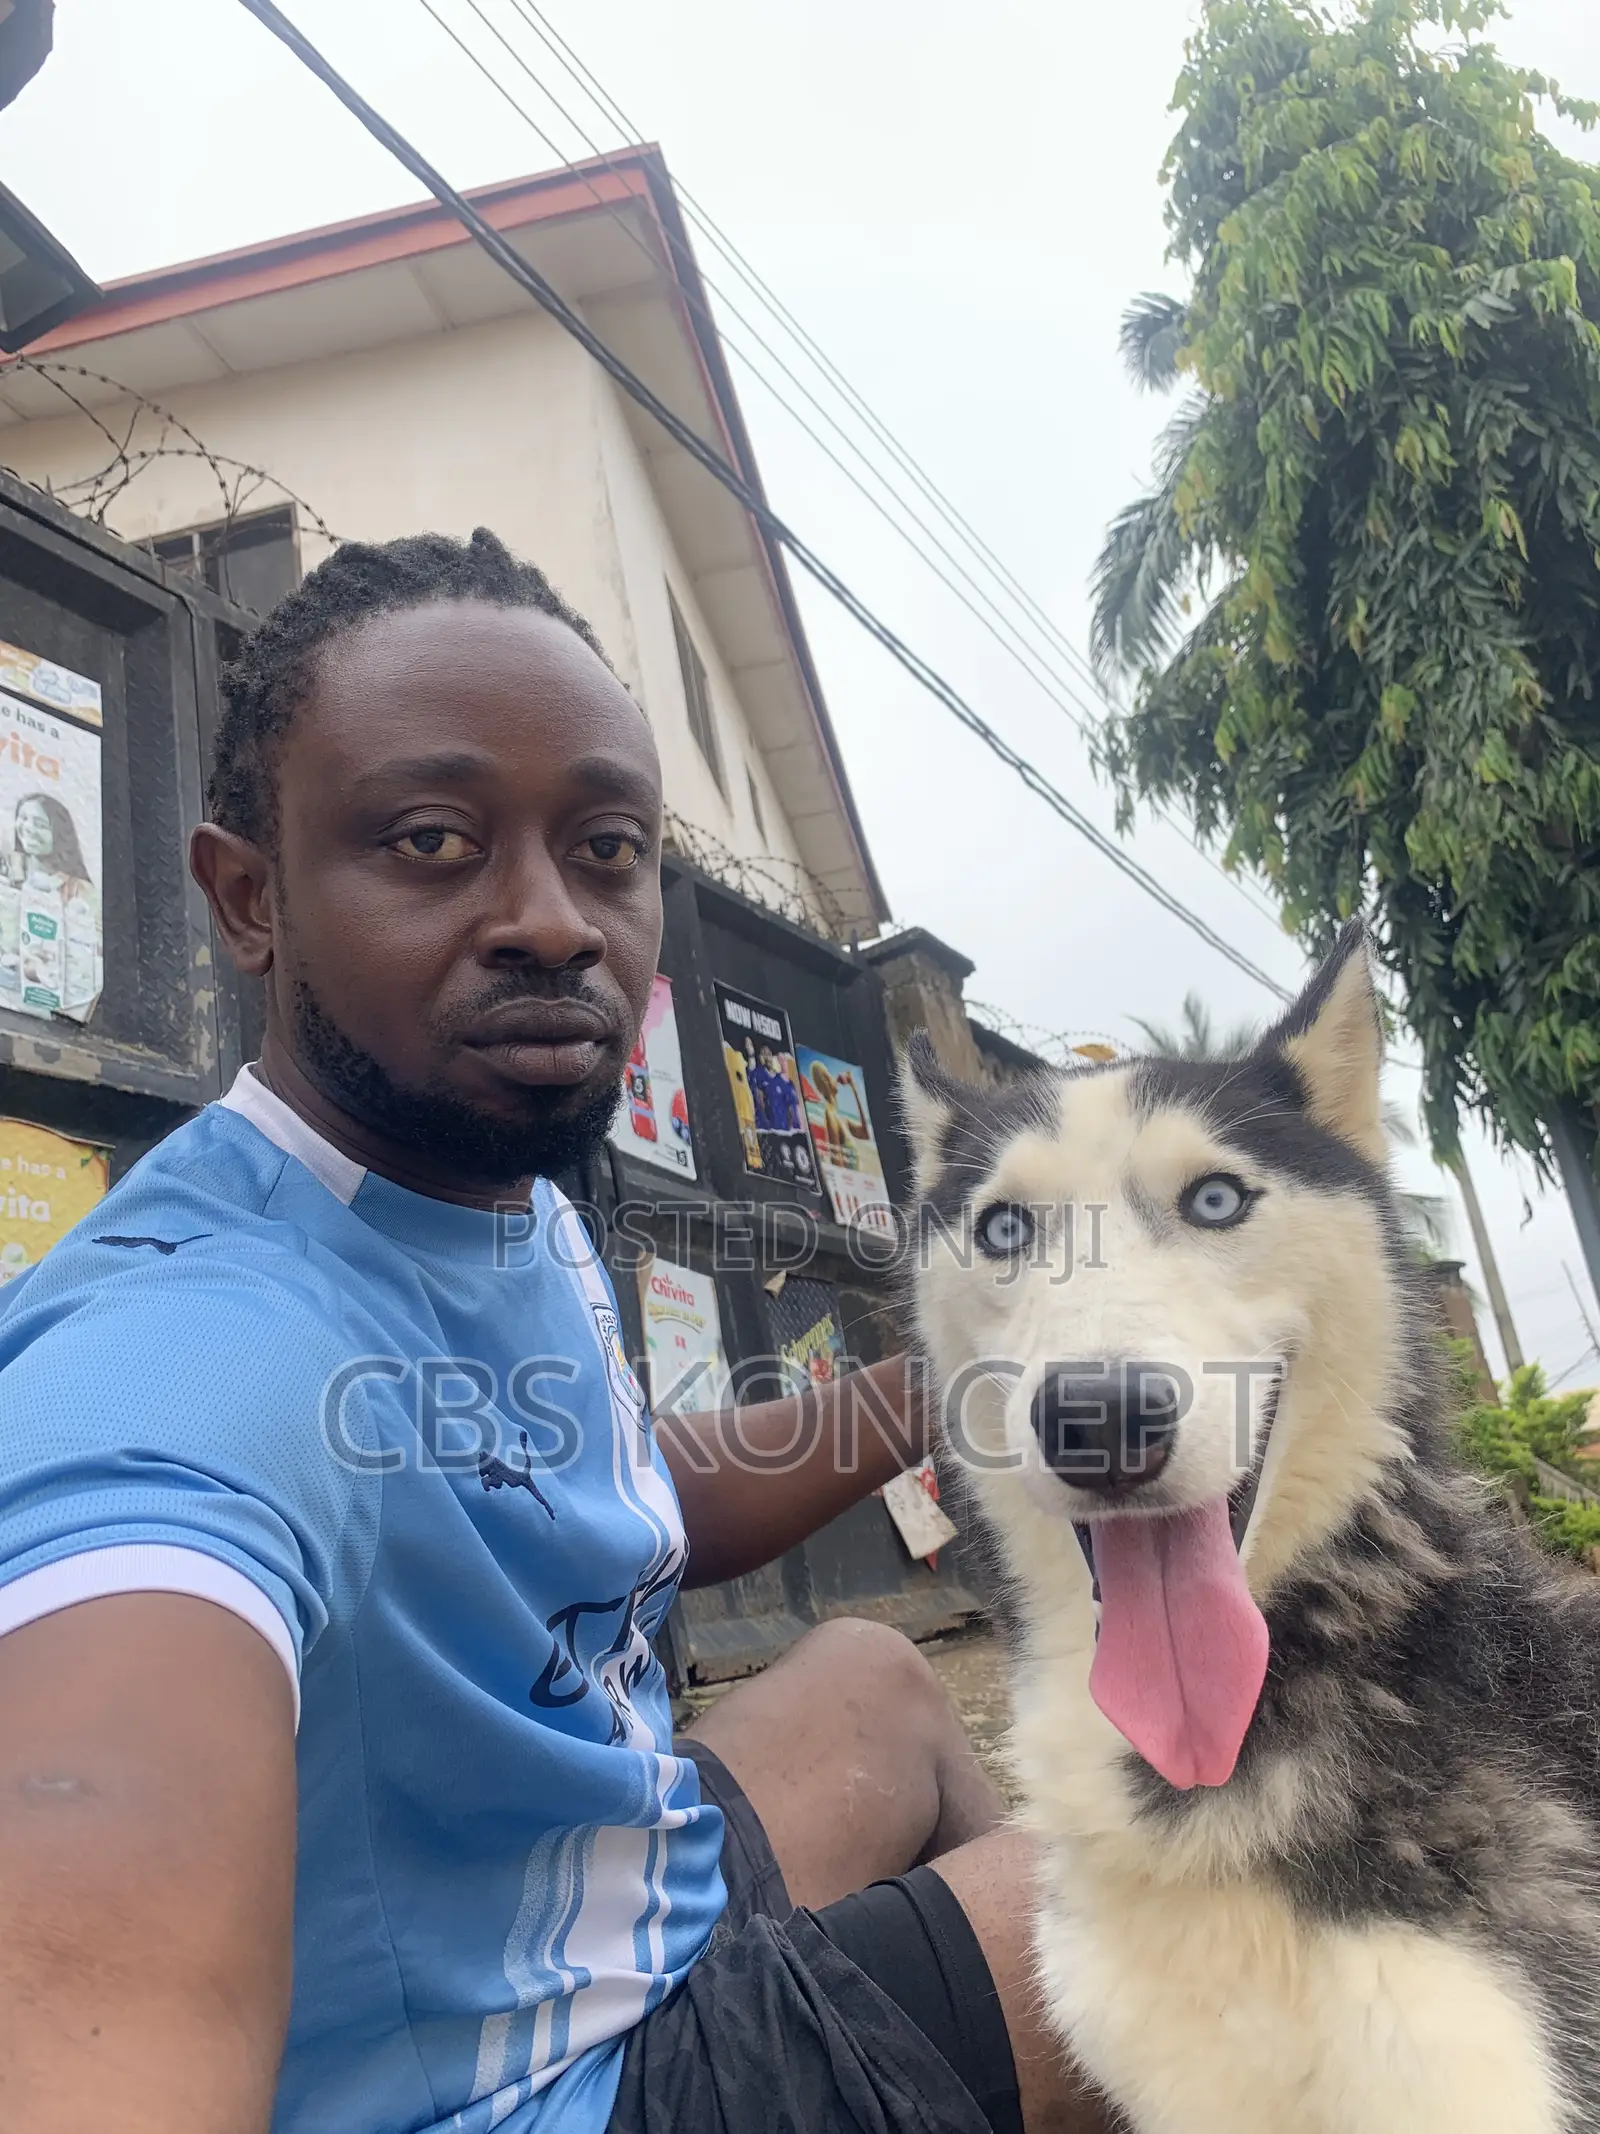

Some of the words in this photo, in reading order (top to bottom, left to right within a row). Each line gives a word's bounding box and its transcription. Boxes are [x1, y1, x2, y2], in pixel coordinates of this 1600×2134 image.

[16, 707, 46, 733] has
[50, 727, 60, 740] a
[724, 998, 752, 1029] NOW
[17, 1155, 51, 1177] has
[56, 1167, 67, 1180] a
[651, 1272, 695, 1308] Chivita
